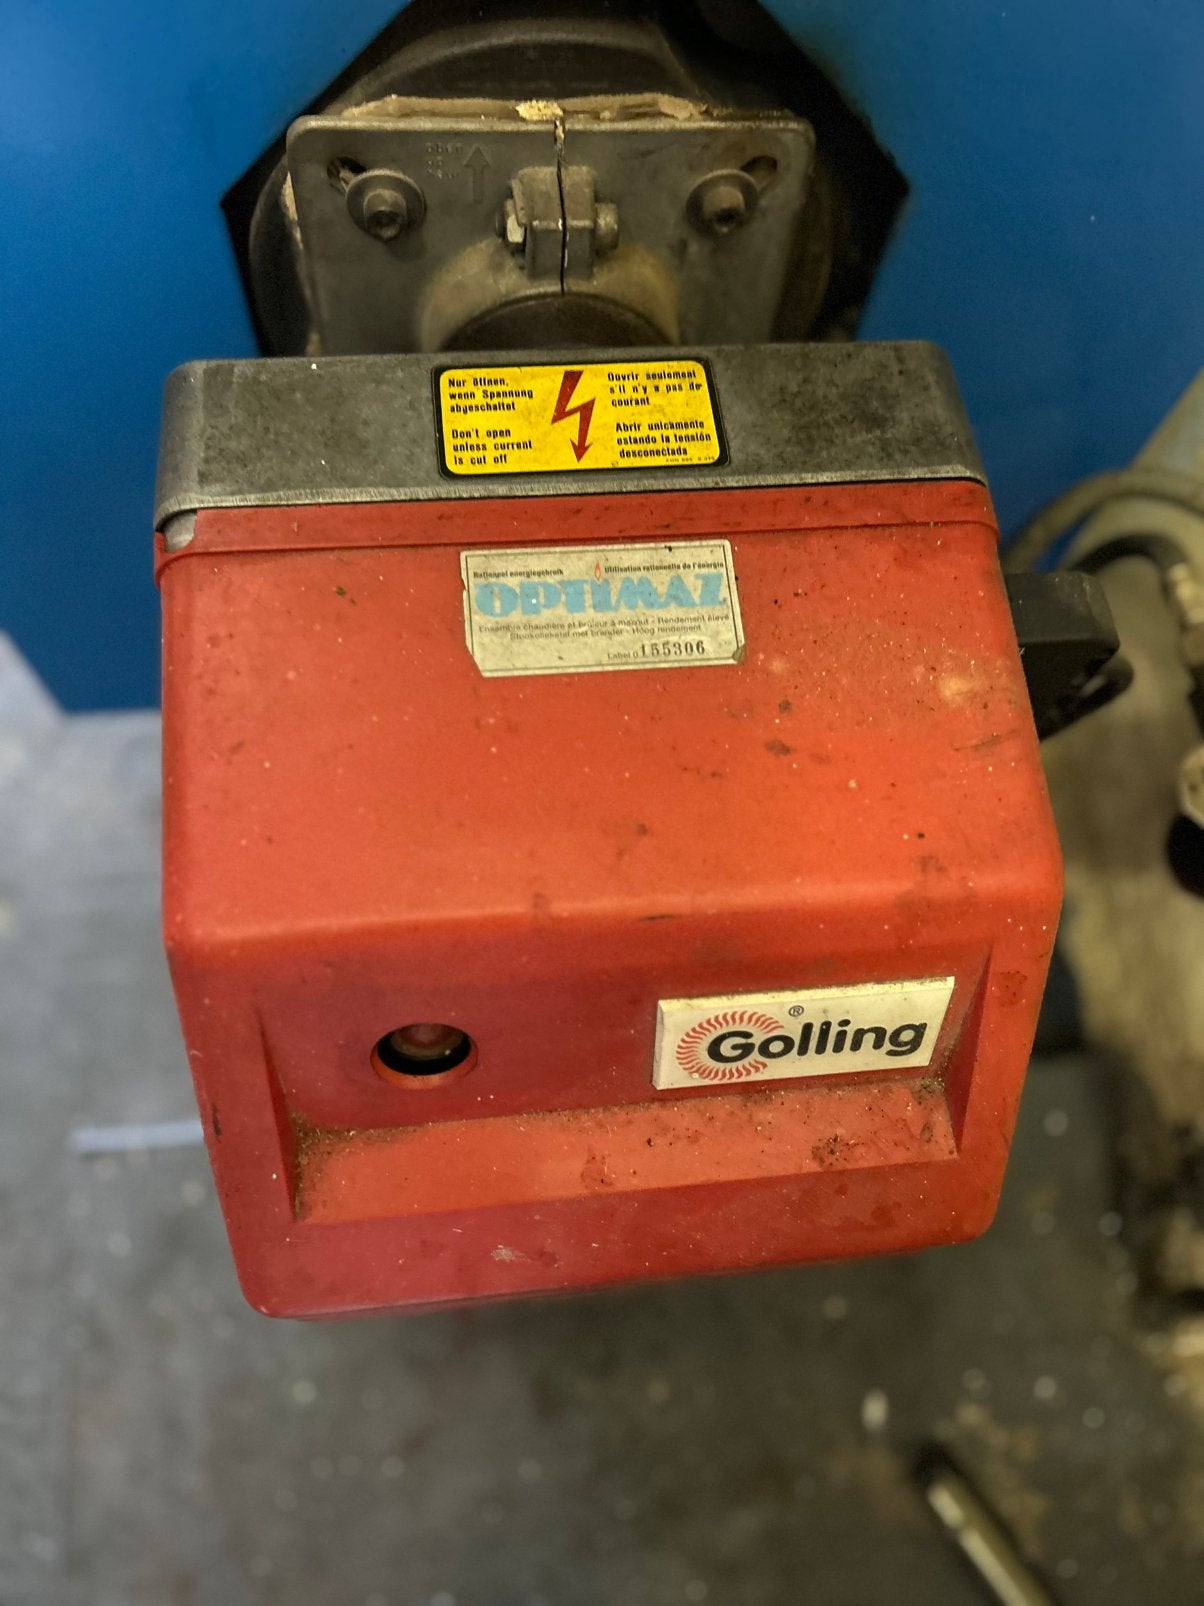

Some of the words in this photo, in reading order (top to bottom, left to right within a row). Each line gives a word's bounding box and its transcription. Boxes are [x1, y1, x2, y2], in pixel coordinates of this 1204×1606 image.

[608, 372, 639, 381] Ouvrir
[646, 370, 696, 380] seulement
[448, 378, 466, 388] Nur
[654, 384, 660, 392] a
[666, 383, 683, 394] pas
[689, 382, 700, 391] de
[449, 391, 476, 400] wenn
[482, 389, 534, 400] Spannung
[450, 402, 516, 414] abgeschaltet
[612, 397, 650, 407] courant
[616, 422, 642, 432] Abrir
[452, 428, 479, 439] Don't
[486, 429, 511, 439] open
[617, 434, 656, 445] estando
[661, 434, 670, 443] la
[674, 432, 711, 443] tensión
[453, 442, 487, 452] unless
[494, 440, 532, 450] current
[620, 446, 688, 458] desconectada
[454, 456, 464, 464] is
[470, 455, 486, 465] cut
[494, 454, 508, 464] off
[604, 565, 641, 574] Utilisation
[682, 562, 692, 570] de
[476, 573, 727, 618] OPTIMAZ
[641, 640, 705, 658] 155306
[707, 1018, 928, 1064] Golling
